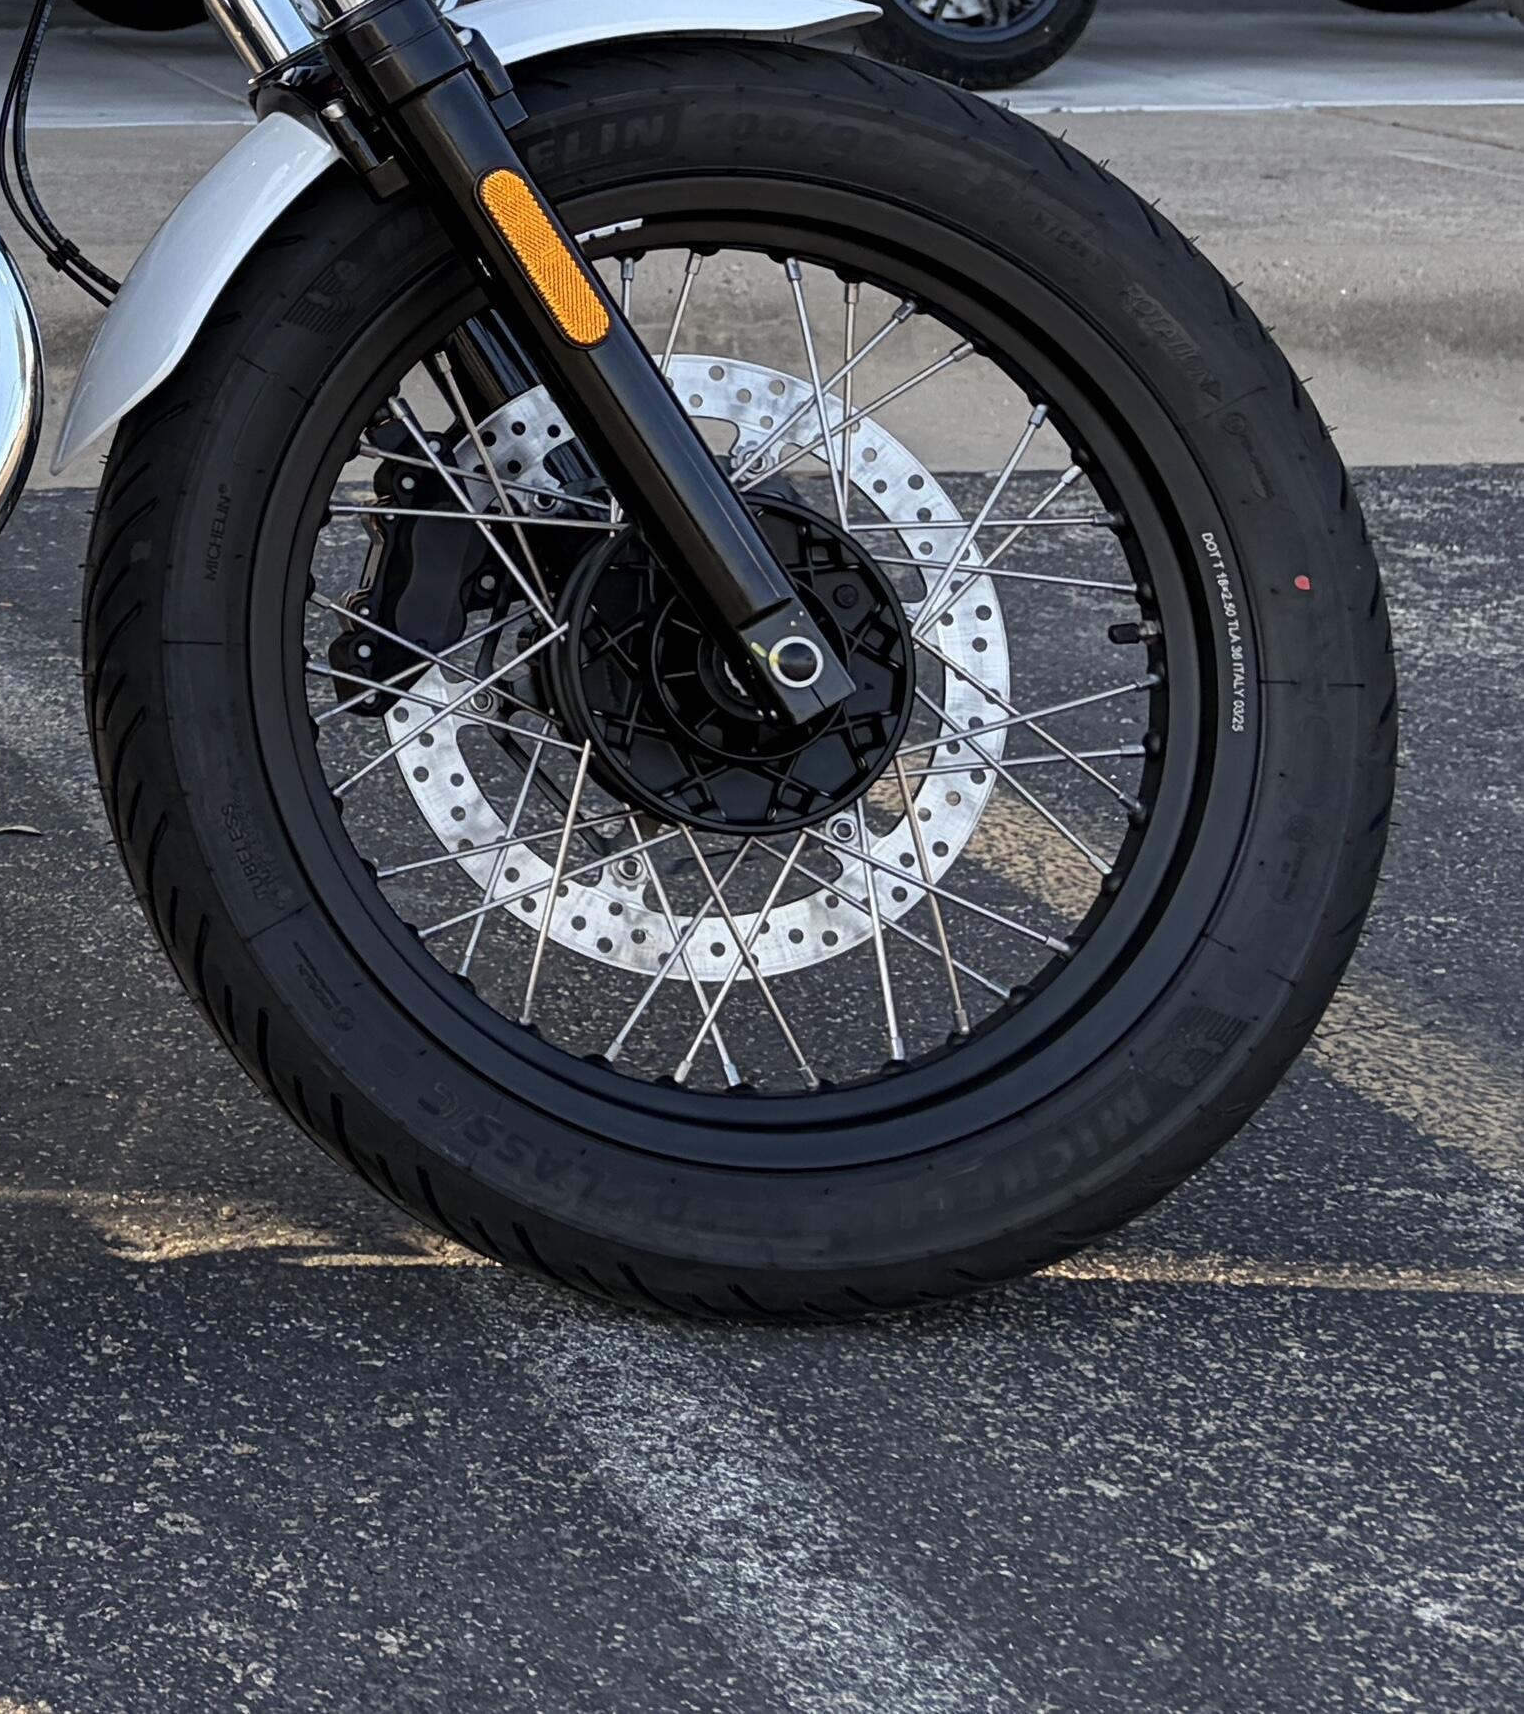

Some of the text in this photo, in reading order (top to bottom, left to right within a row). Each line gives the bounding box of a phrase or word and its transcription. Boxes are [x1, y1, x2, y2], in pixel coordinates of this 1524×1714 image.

[1202, 532, 1222, 558] DOT
[1228, 619, 1241, 644] TLA
[1233, 662, 1245, 697] ITALY
[1232, 699, 1245, 732] 03/25
[221, 804, 266, 900] TUBELESS
